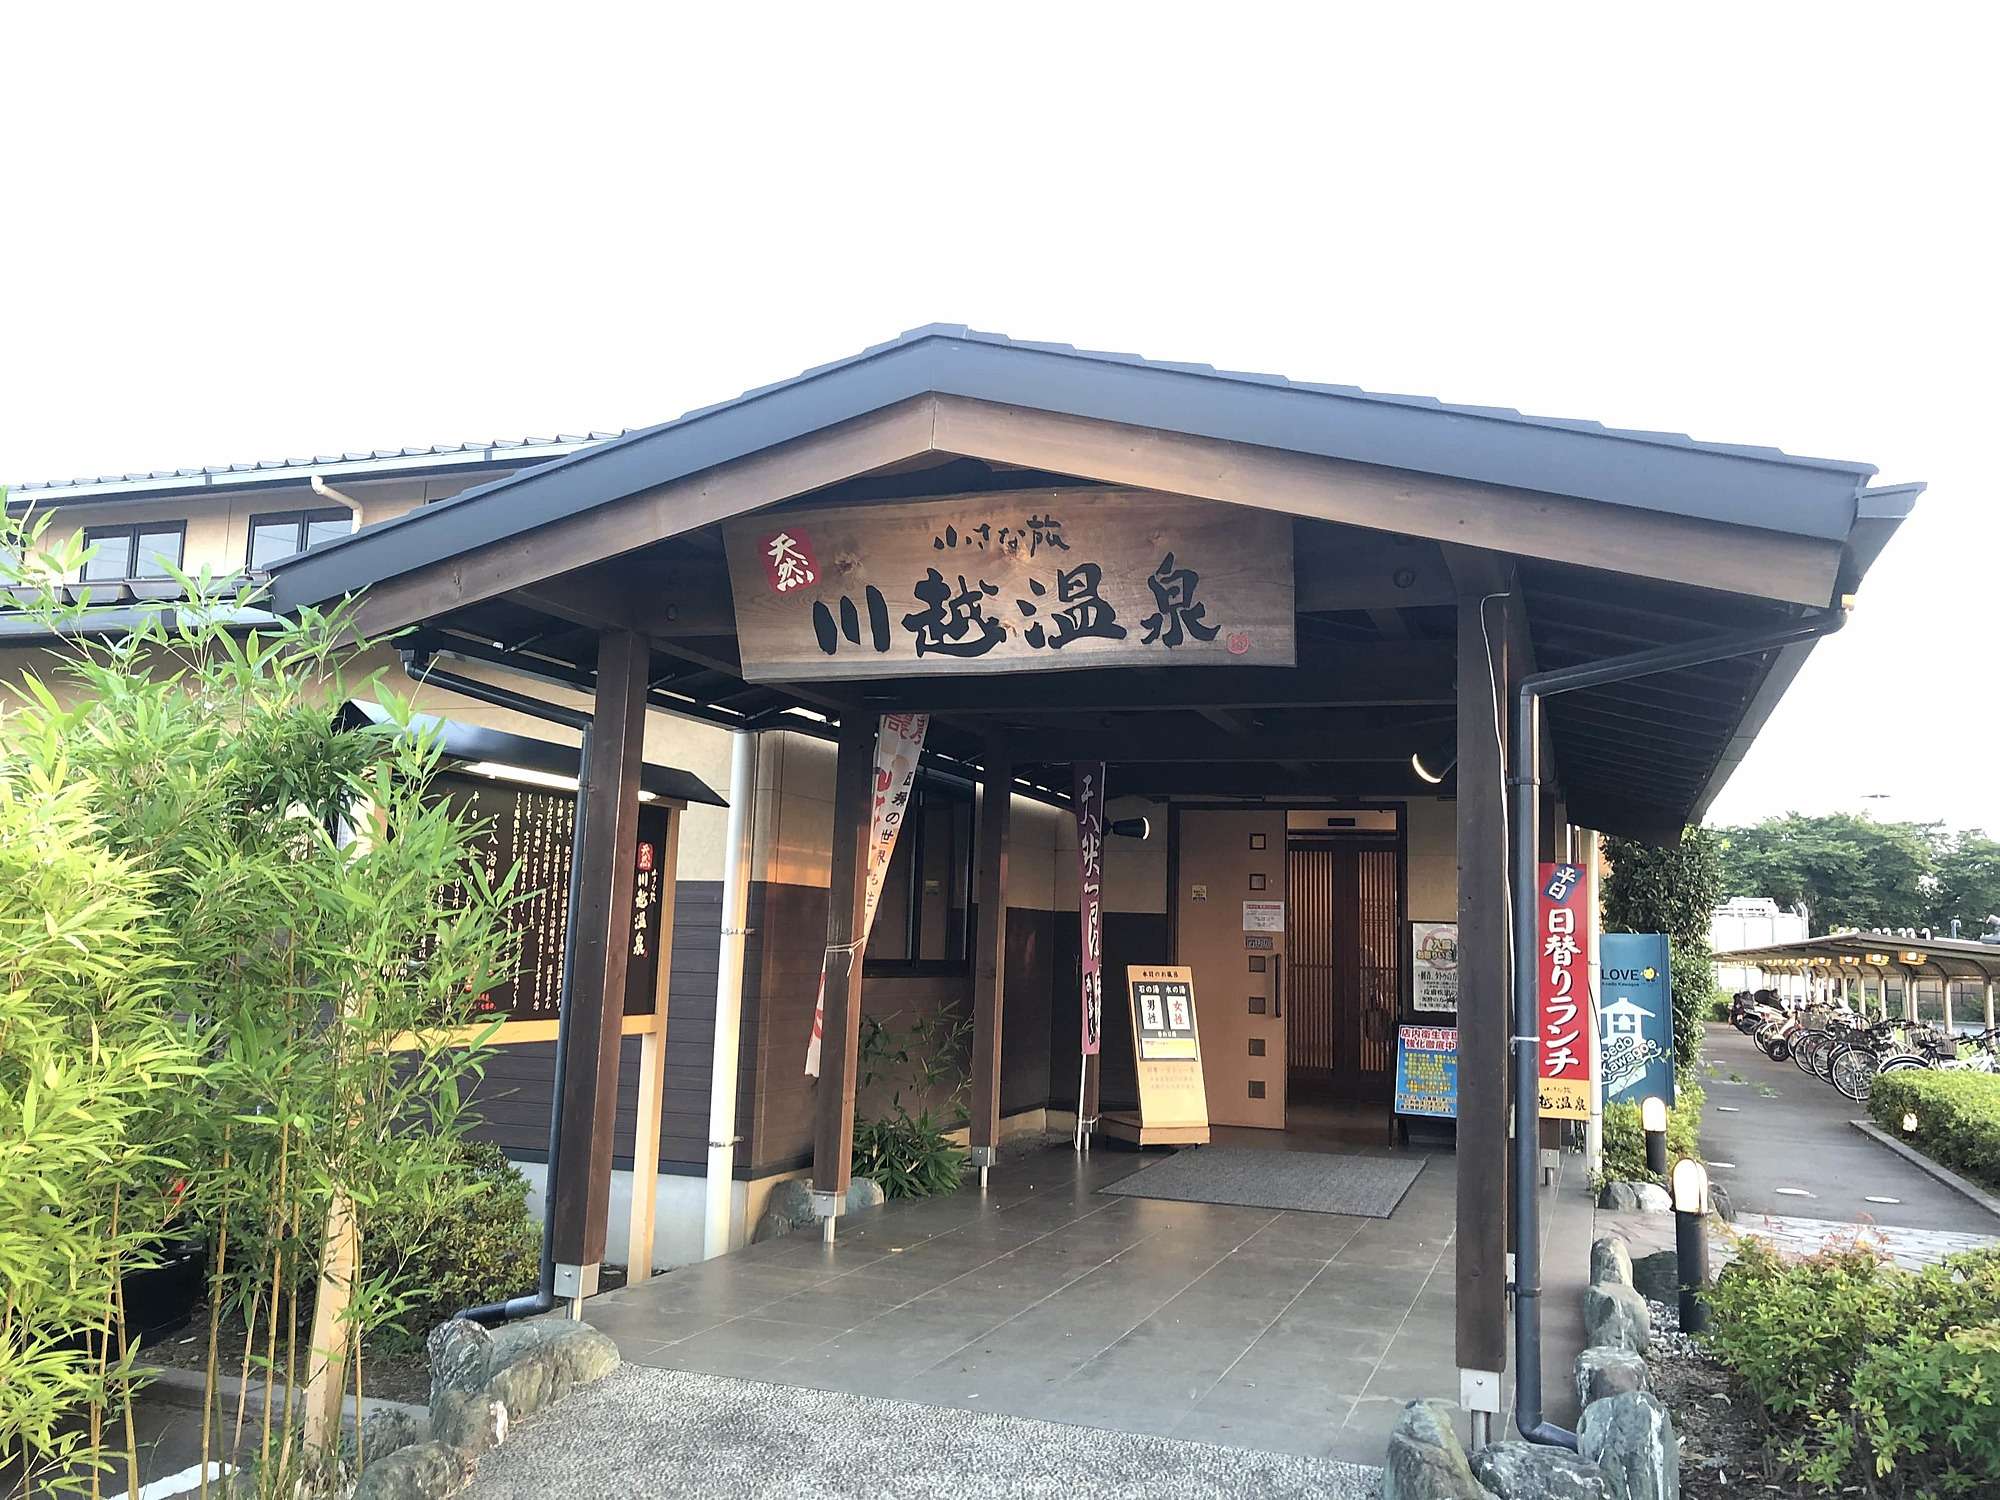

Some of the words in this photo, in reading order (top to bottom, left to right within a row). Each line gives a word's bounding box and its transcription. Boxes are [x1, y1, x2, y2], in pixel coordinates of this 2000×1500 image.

[934, 514, 1071, 557] 小さな旅
[767, 532, 815, 592] 天然
[812, 552, 1221, 658] 川越温泉
[1548, 868, 1576, 901] 平日
[633, 871, 649, 956] 川越温泉
[1543, 908, 1581, 1077] 日替りランチ
[1601, 969, 1639, 981] LOVE
[1147, 999, 1158, 1024] 男性
[1173, 1000, 1185, 1024] 女性
[1602, 1036, 1633, 1061] oedo
[1602, 1039, 1657, 1076] Kawagoe
